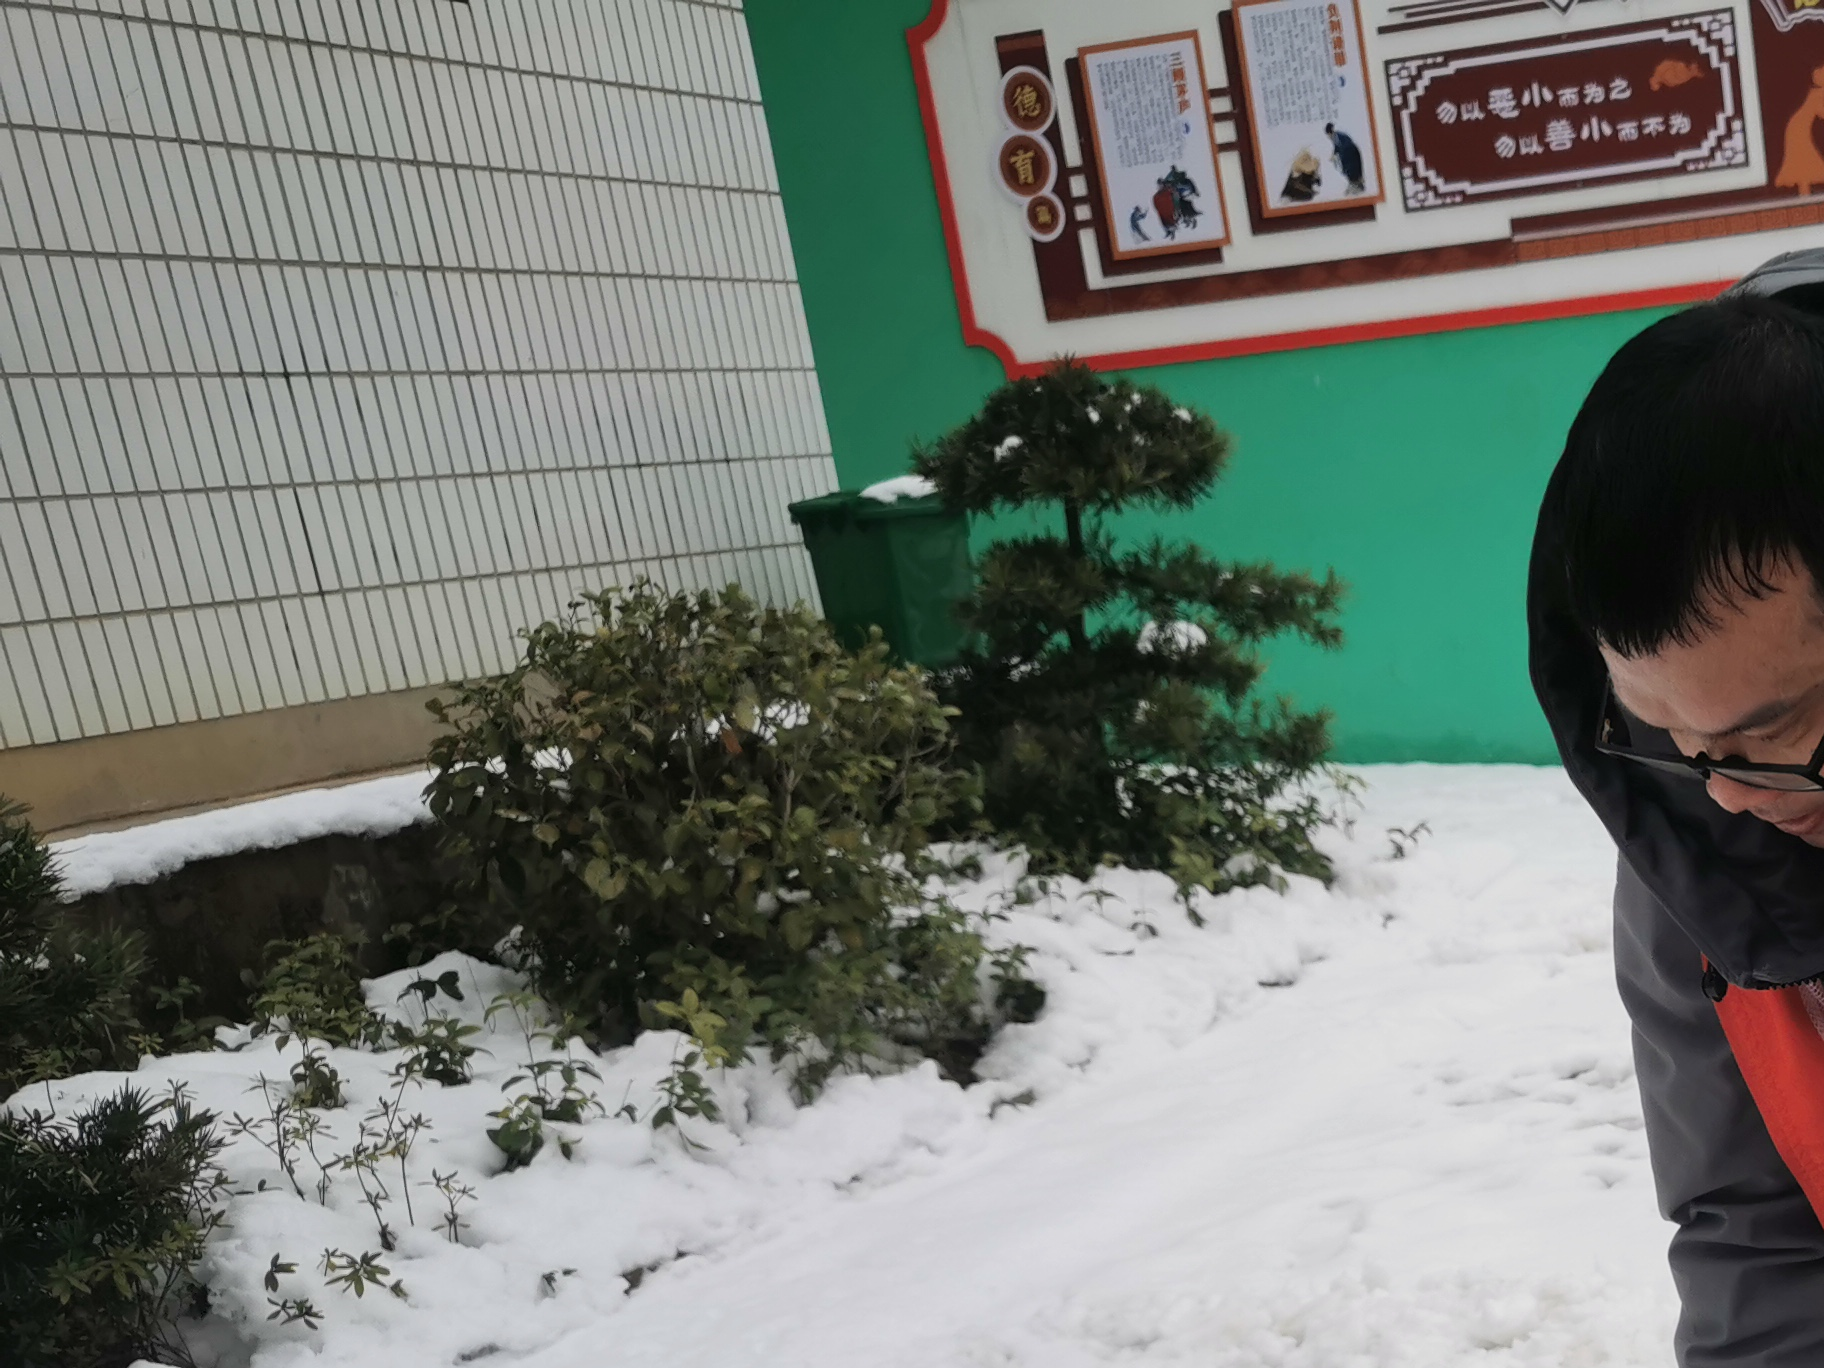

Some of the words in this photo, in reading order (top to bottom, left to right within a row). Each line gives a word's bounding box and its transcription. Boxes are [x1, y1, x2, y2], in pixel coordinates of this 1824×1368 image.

[1435, 75, 1633, 125] 勿以恶小而为之
[1493, 109, 1692, 159] 勿以善小而不为
